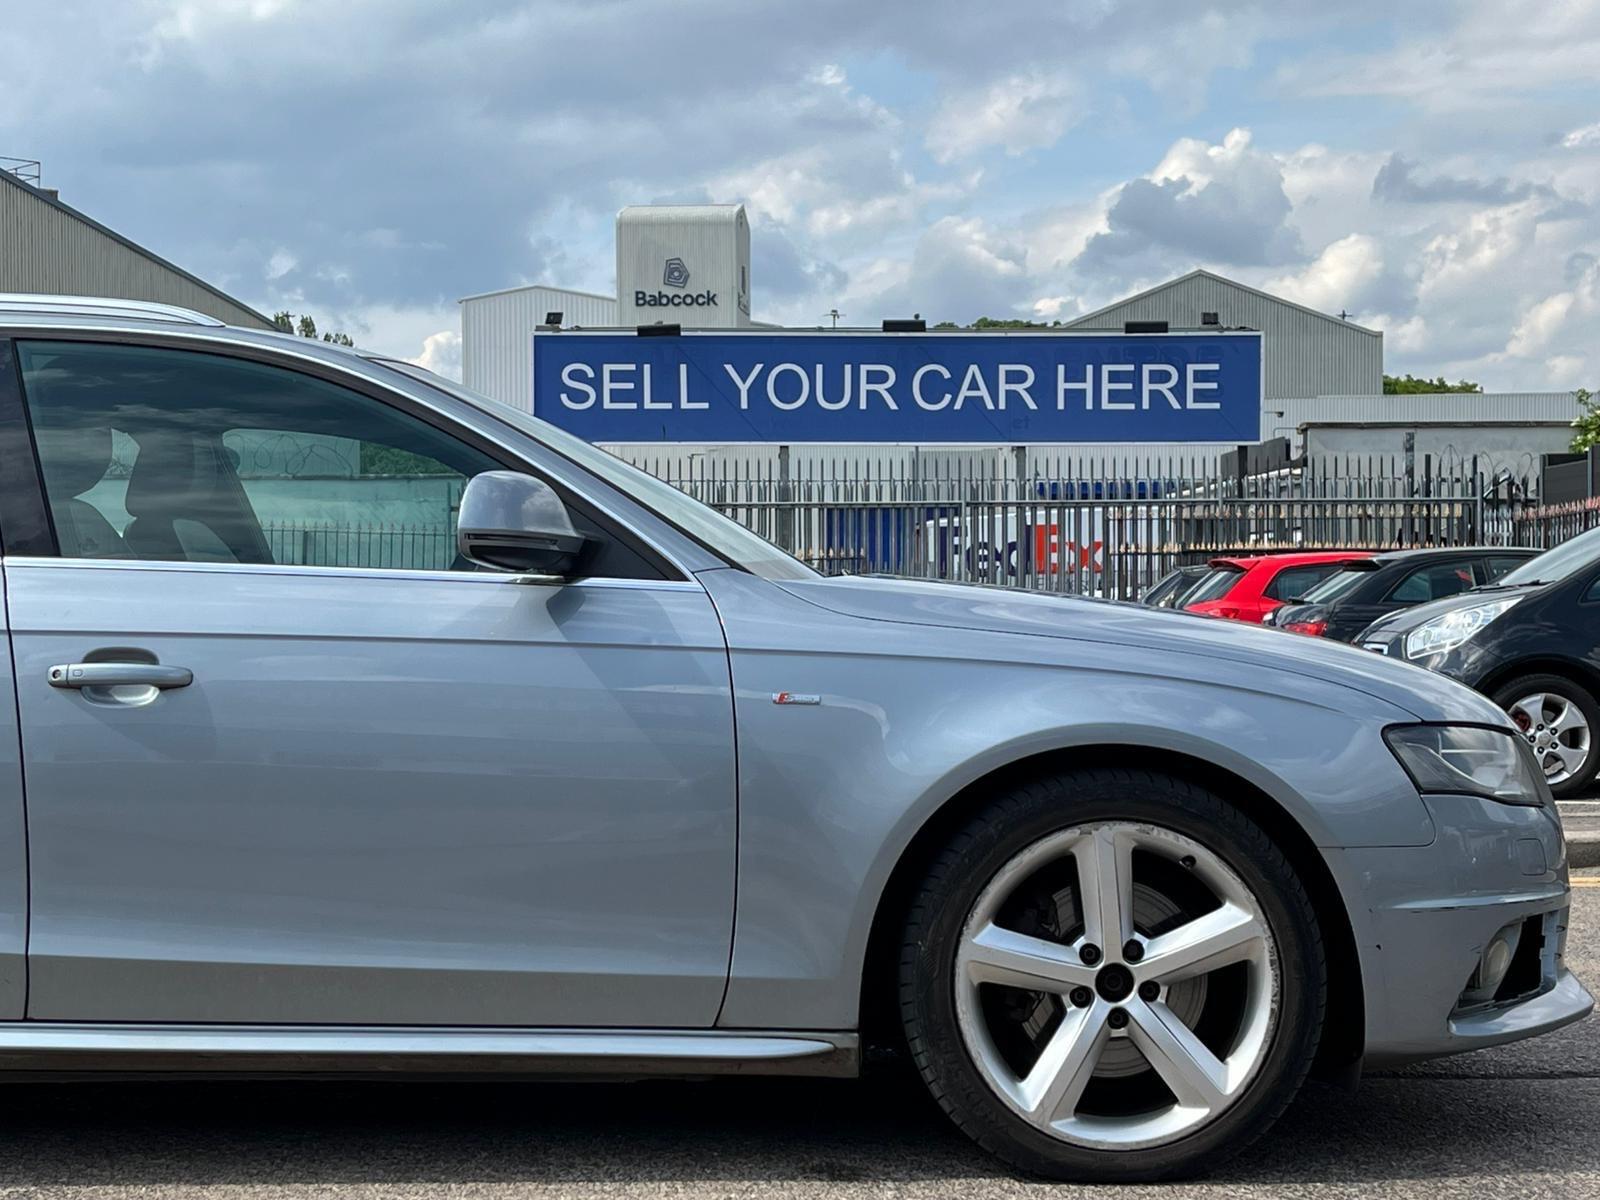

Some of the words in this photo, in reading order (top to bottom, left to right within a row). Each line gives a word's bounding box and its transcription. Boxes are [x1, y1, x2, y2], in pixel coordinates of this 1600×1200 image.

[635, 290, 718, 307] Babcock
[560, 362, 710, 411] SELL
[723, 362, 899, 411] YOUR
[912, 362, 1038, 411] CAR
[1057, 363, 1221, 411] HERE
[937, 523, 1104, 578] FedEx
